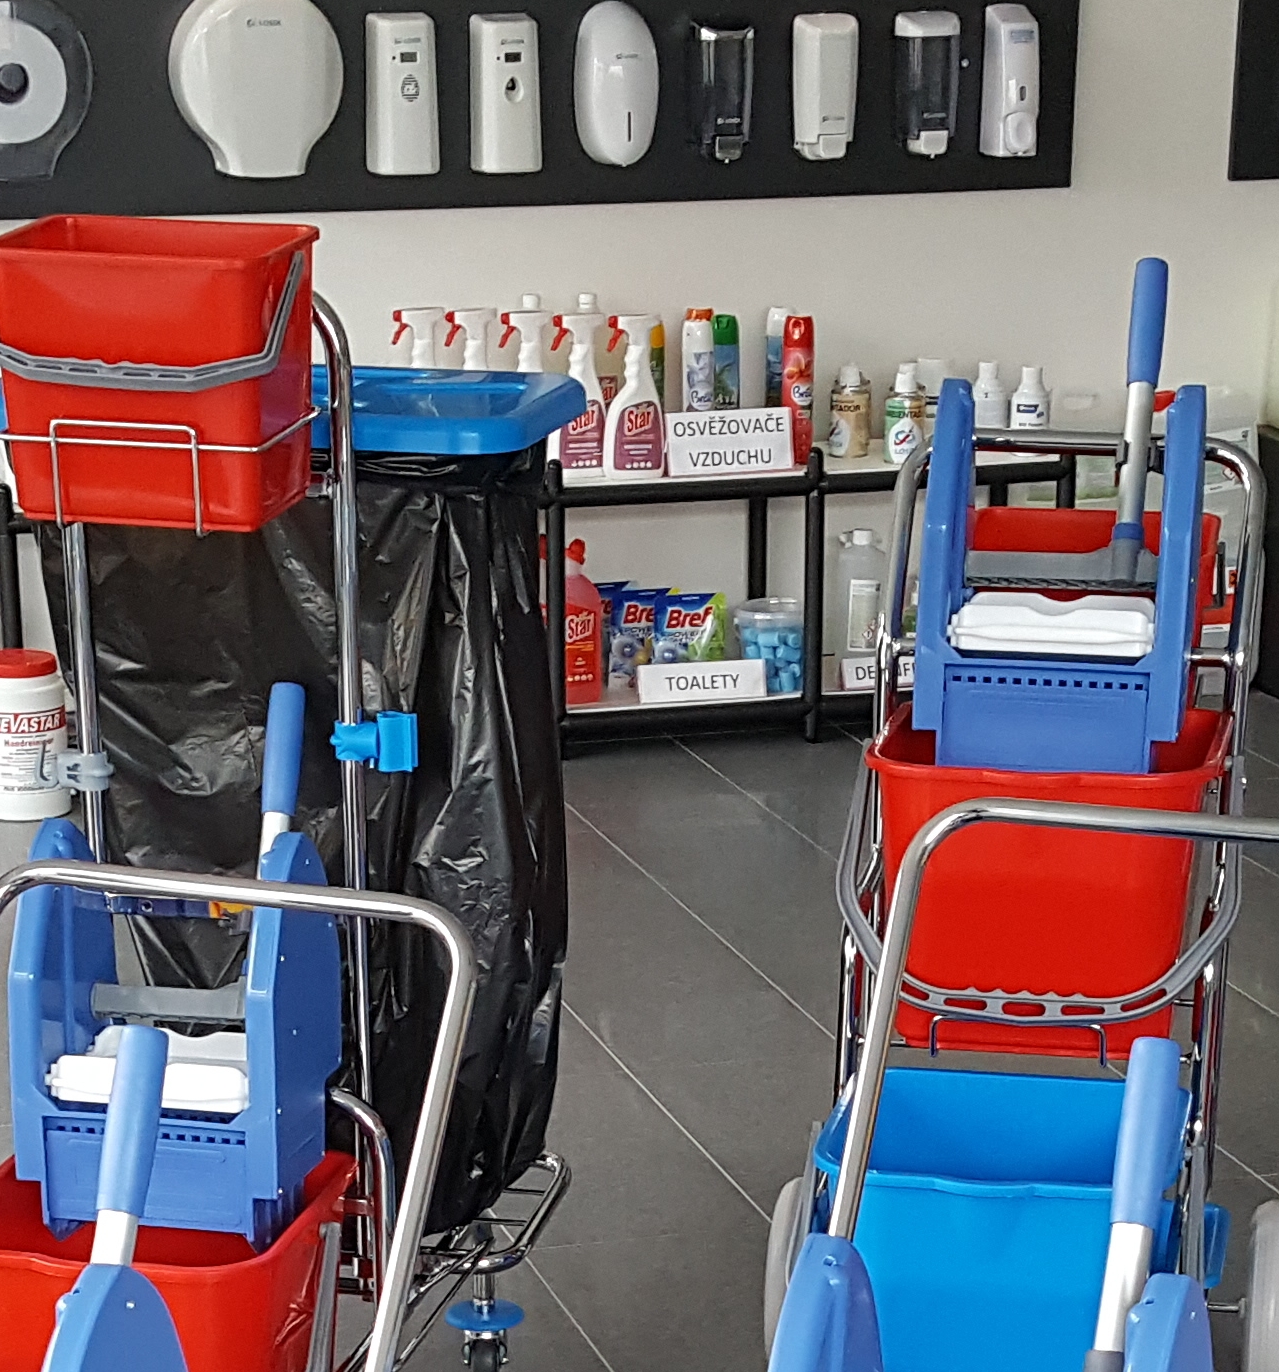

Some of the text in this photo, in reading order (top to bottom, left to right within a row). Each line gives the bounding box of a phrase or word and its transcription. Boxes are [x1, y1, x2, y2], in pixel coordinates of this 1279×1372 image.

[627, 410, 652, 433] Star
[674, 413, 785, 438] OSVĚŽOVAČE
[689, 448, 773, 468] VZDUCHU
[623, 604, 654, 624] Bre
[666, 606, 713, 629] Bref
[568, 616, 593, 639] Star
[665, 674, 740, 691] TOALETY
